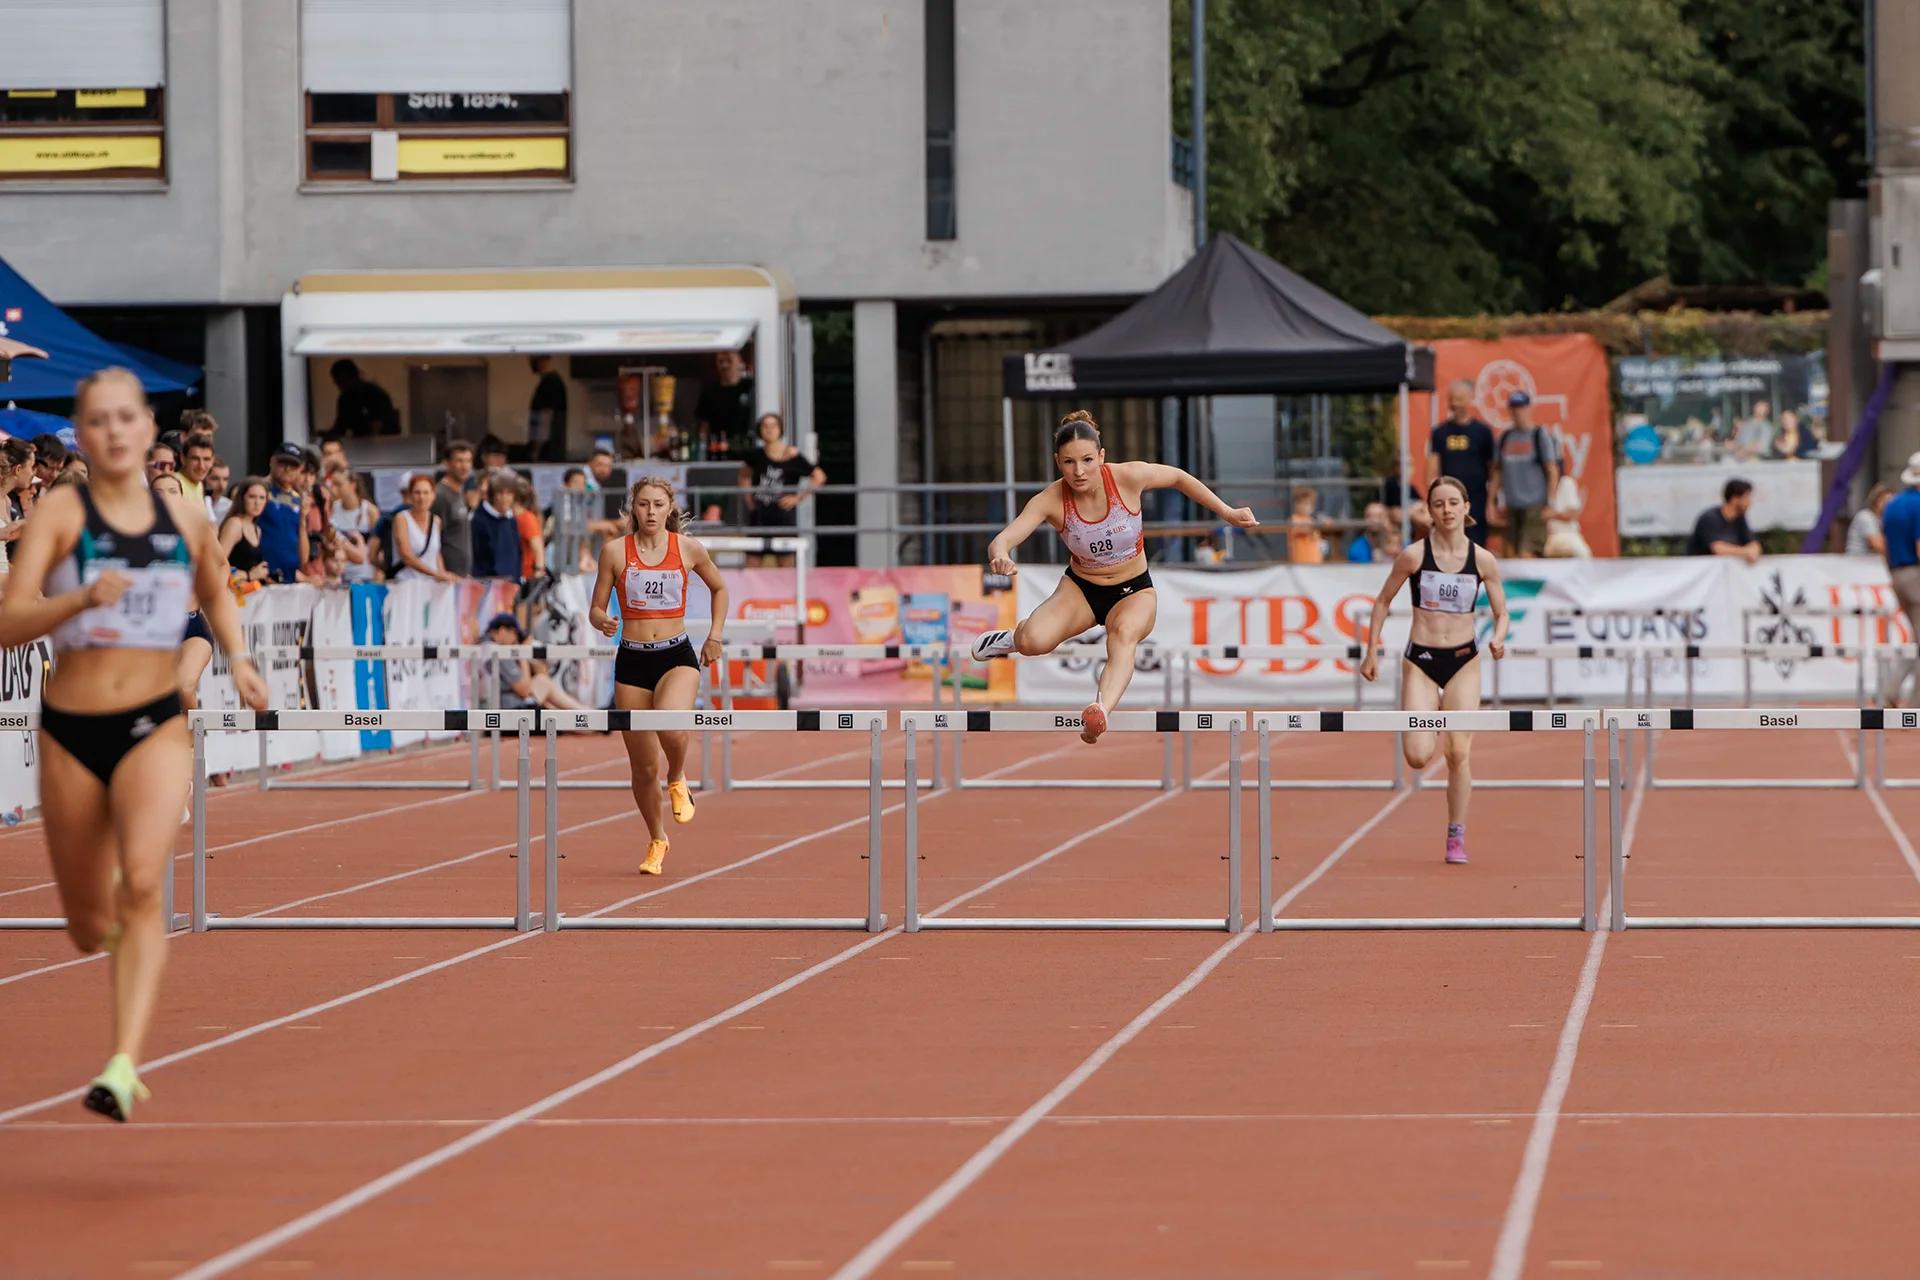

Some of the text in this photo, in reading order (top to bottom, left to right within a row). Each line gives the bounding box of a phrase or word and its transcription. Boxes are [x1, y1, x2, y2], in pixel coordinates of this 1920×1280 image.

[1089, 539, 1113, 554] 628
[645, 581, 664, 594] 221
[1439, 583, 1459, 598] 606
[0, 716, 28, 727] asel
[344, 714, 382, 726] Basel
[694, 714, 732, 726] Basel
[1408, 717, 1447, 728] Basel
[1760, 715, 1798, 726] Basel
